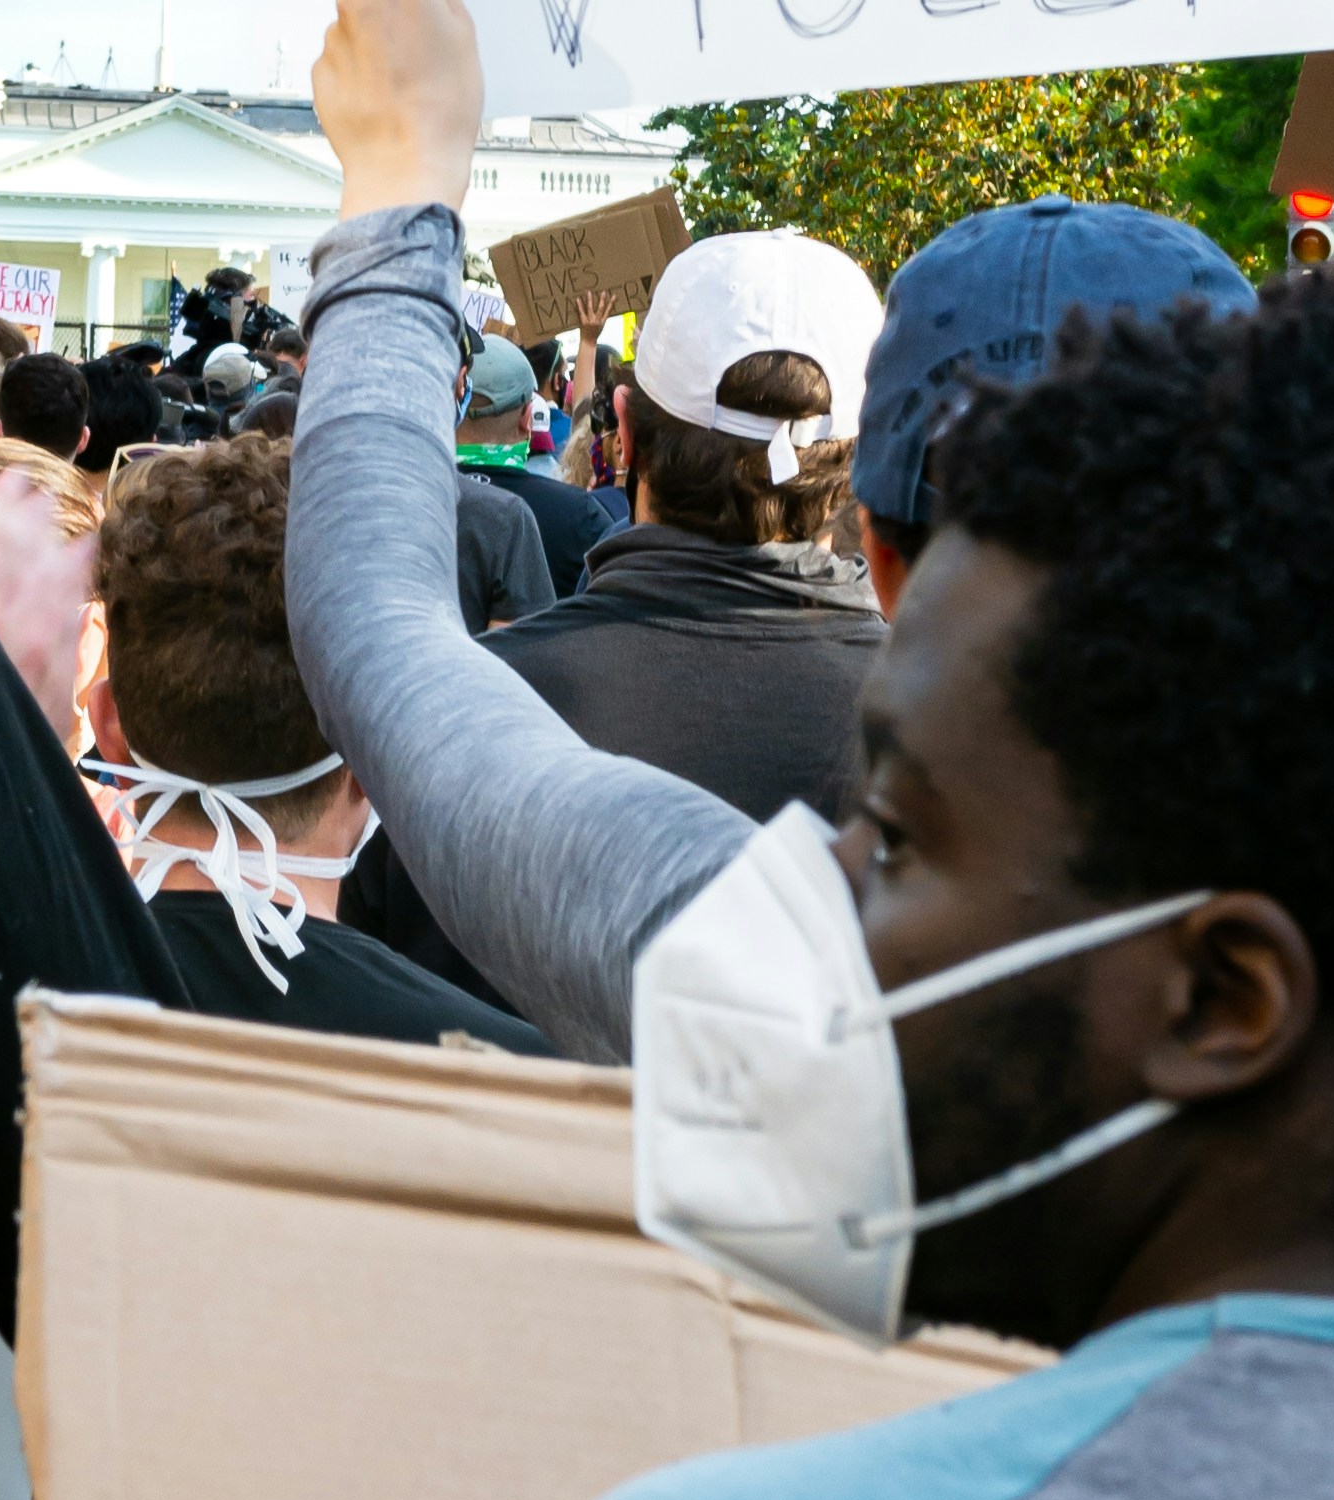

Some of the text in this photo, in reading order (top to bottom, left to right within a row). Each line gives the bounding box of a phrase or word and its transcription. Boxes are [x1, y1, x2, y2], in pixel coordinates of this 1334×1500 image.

[518, 228, 595, 275] BLACK
[14, 267, 52, 297] OUR
[528, 262, 600, 302] LIVES
